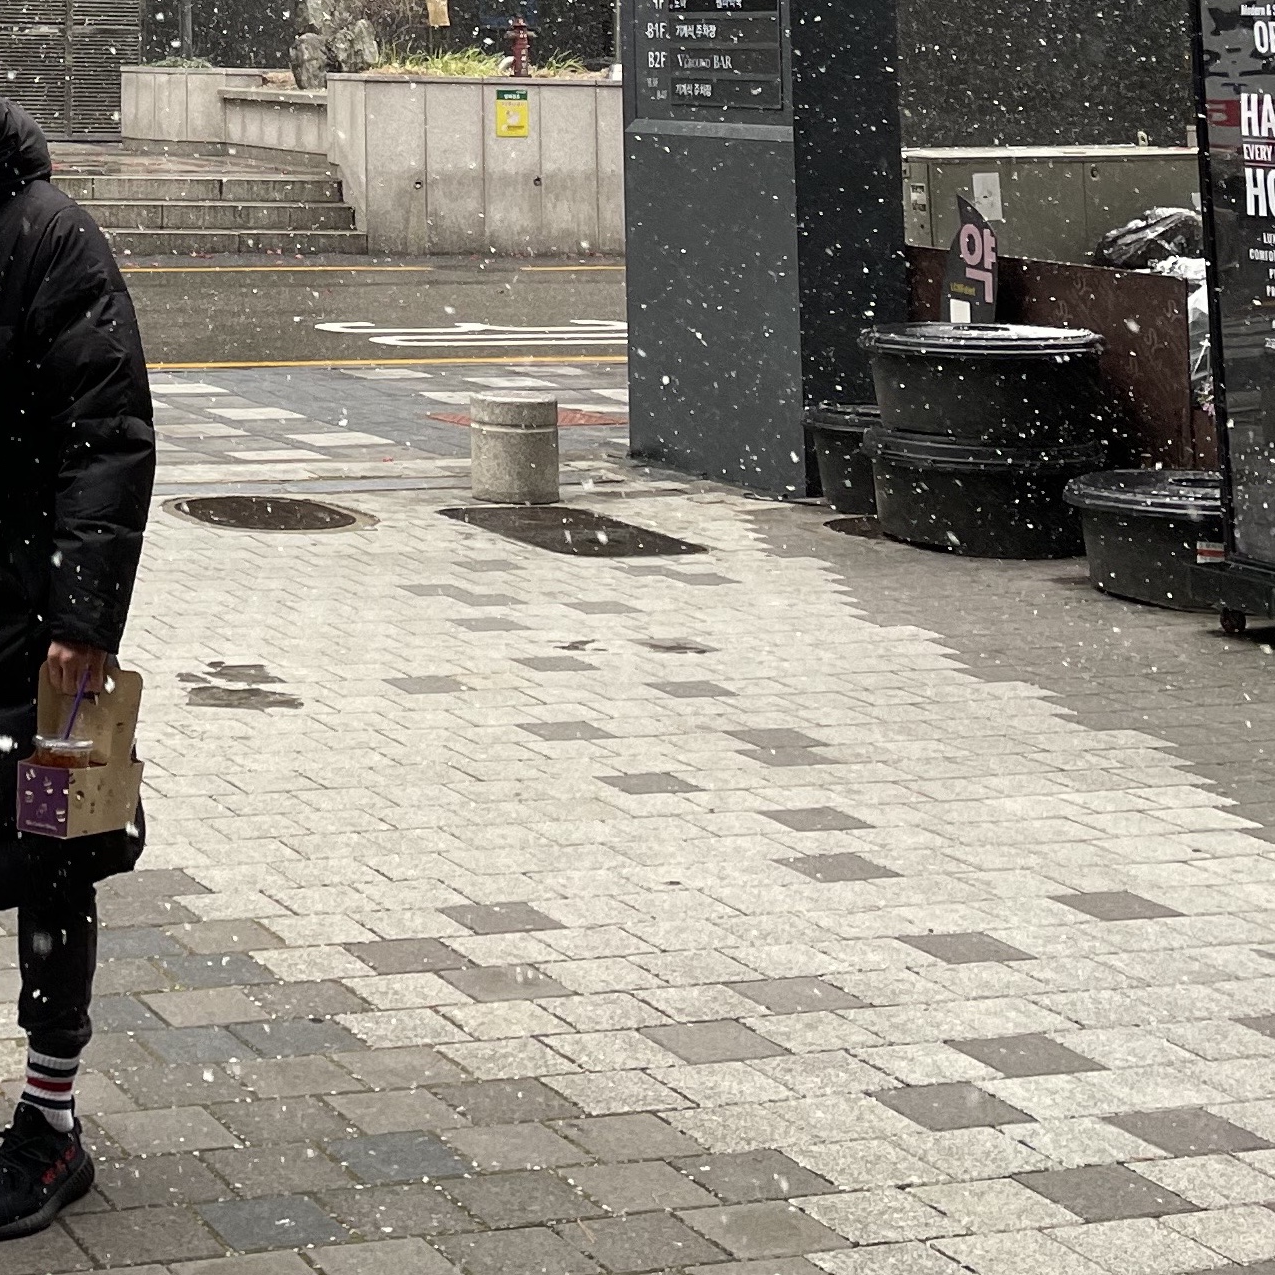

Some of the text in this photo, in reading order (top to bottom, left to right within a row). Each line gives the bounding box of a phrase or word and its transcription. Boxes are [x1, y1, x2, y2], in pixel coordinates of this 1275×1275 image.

[647, 23, 667, 39] B1F
[648, 51, 667, 68] B2F
[713, 55, 732, 69] BAR
[1243, 144, 1273, 162] EVERY
[960, 223, 996, 303] 약
